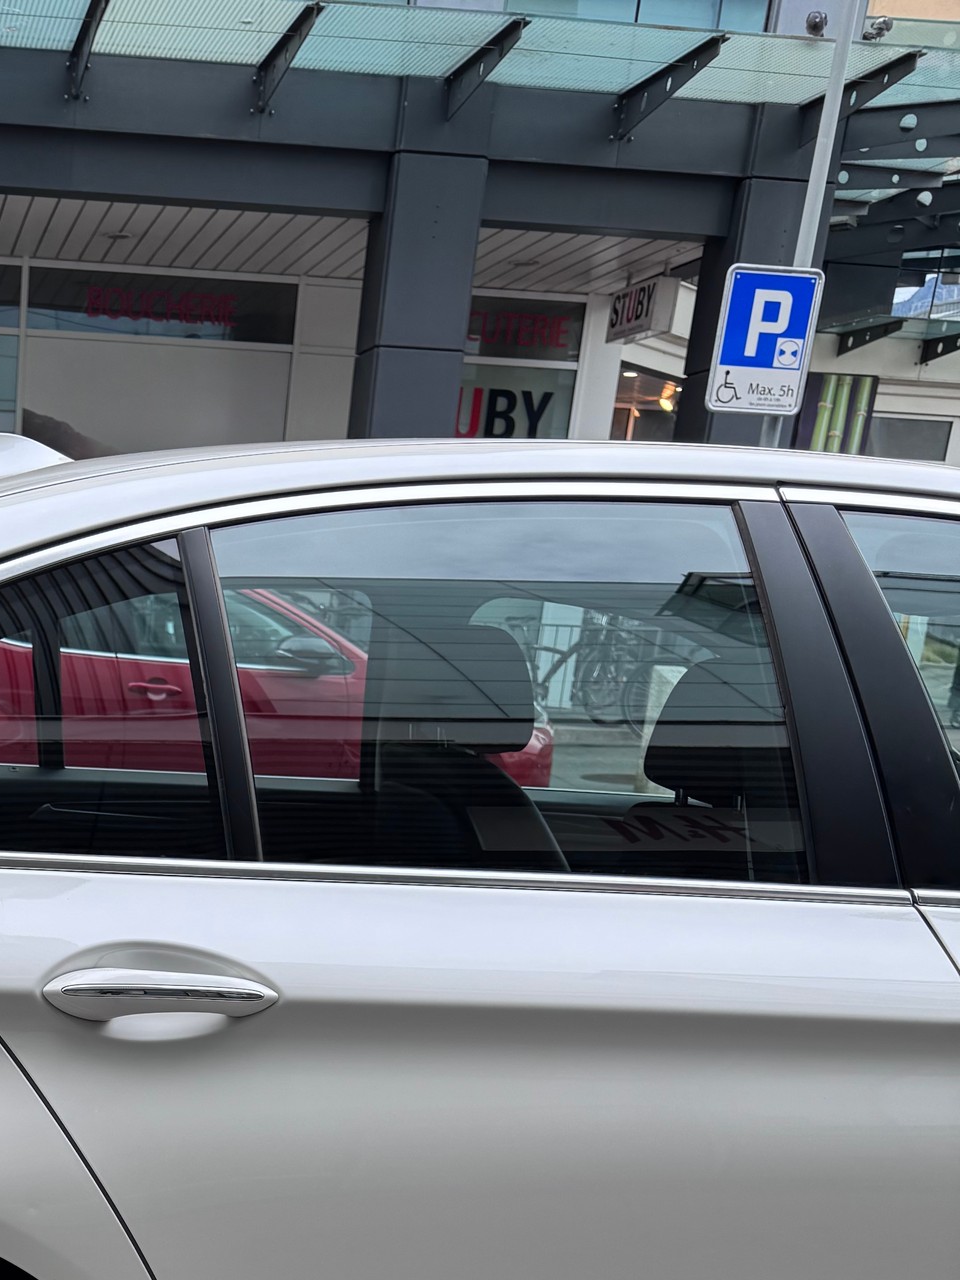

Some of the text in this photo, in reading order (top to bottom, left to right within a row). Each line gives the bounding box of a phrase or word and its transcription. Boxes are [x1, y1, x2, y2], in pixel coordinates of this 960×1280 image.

[86, 285, 240, 328] BOUCHERIE
[610, 282, 657, 329] STUBY
[744, 288, 793, 357] P
[747, 382, 794, 398] Max. 5h
